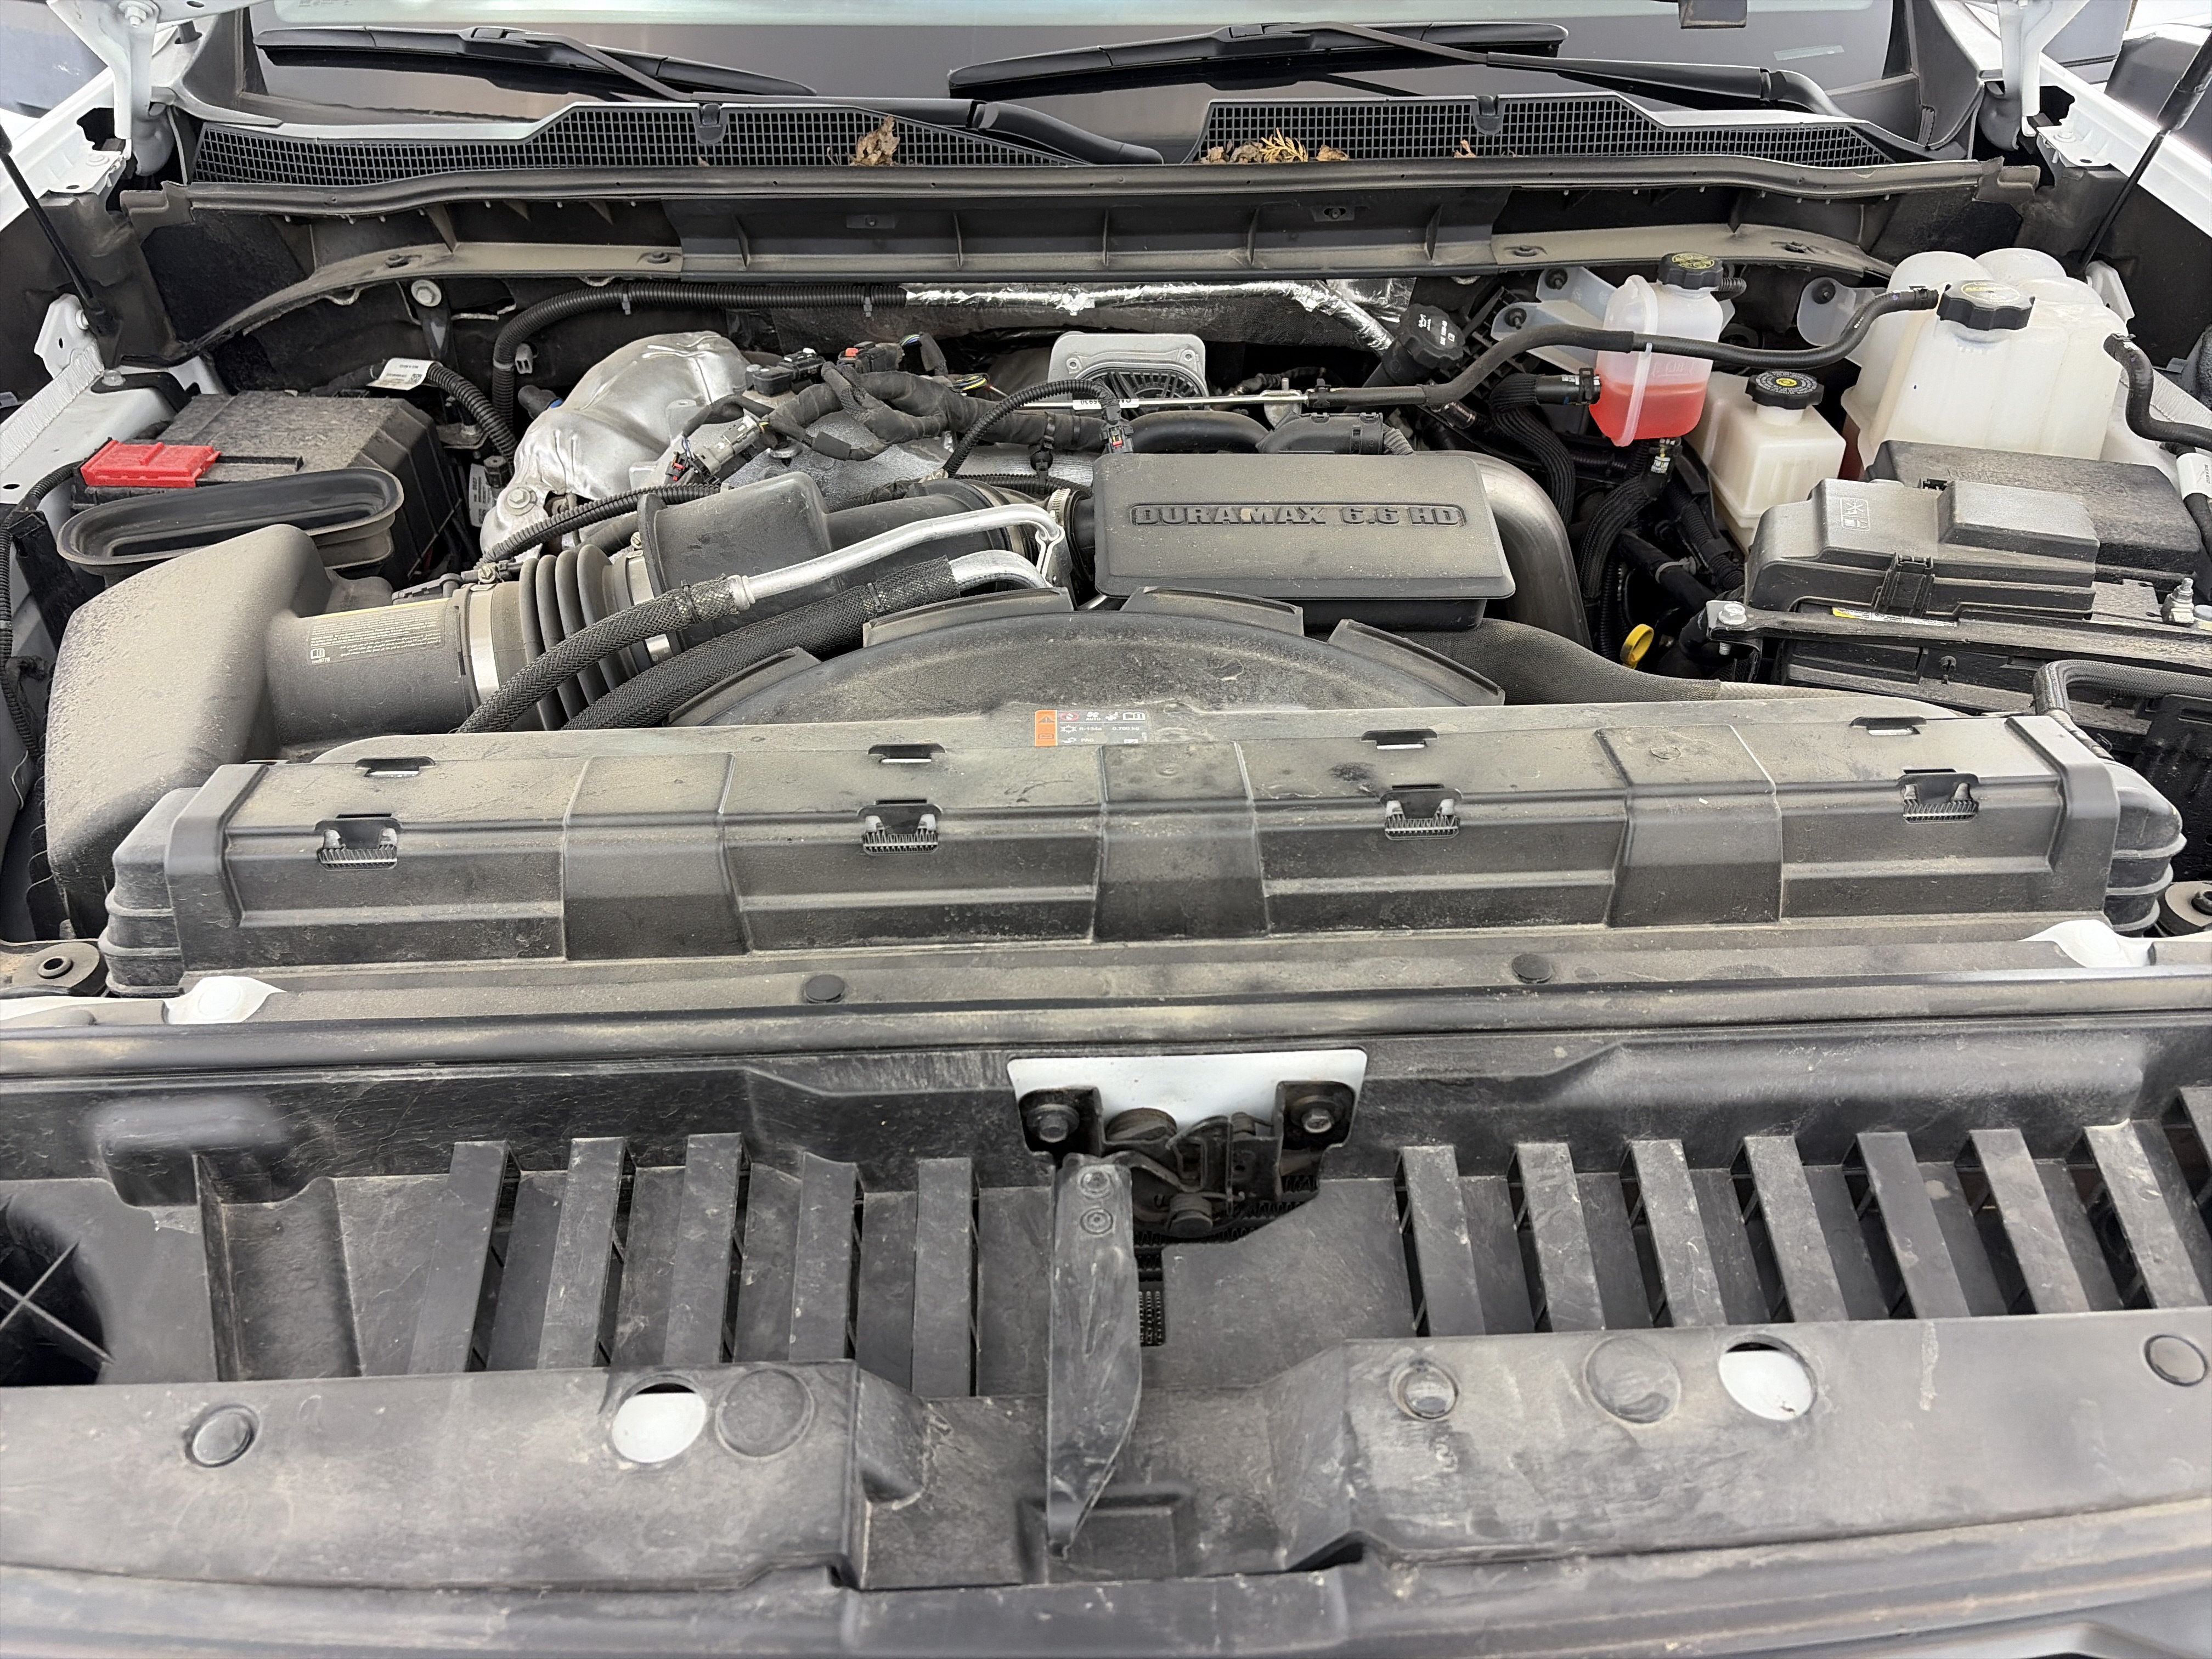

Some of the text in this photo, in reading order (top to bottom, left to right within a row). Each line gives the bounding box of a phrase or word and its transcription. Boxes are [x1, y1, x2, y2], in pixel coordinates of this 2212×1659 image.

[1136, 505, 1459, 525] DURAMAX 6.6 HD
